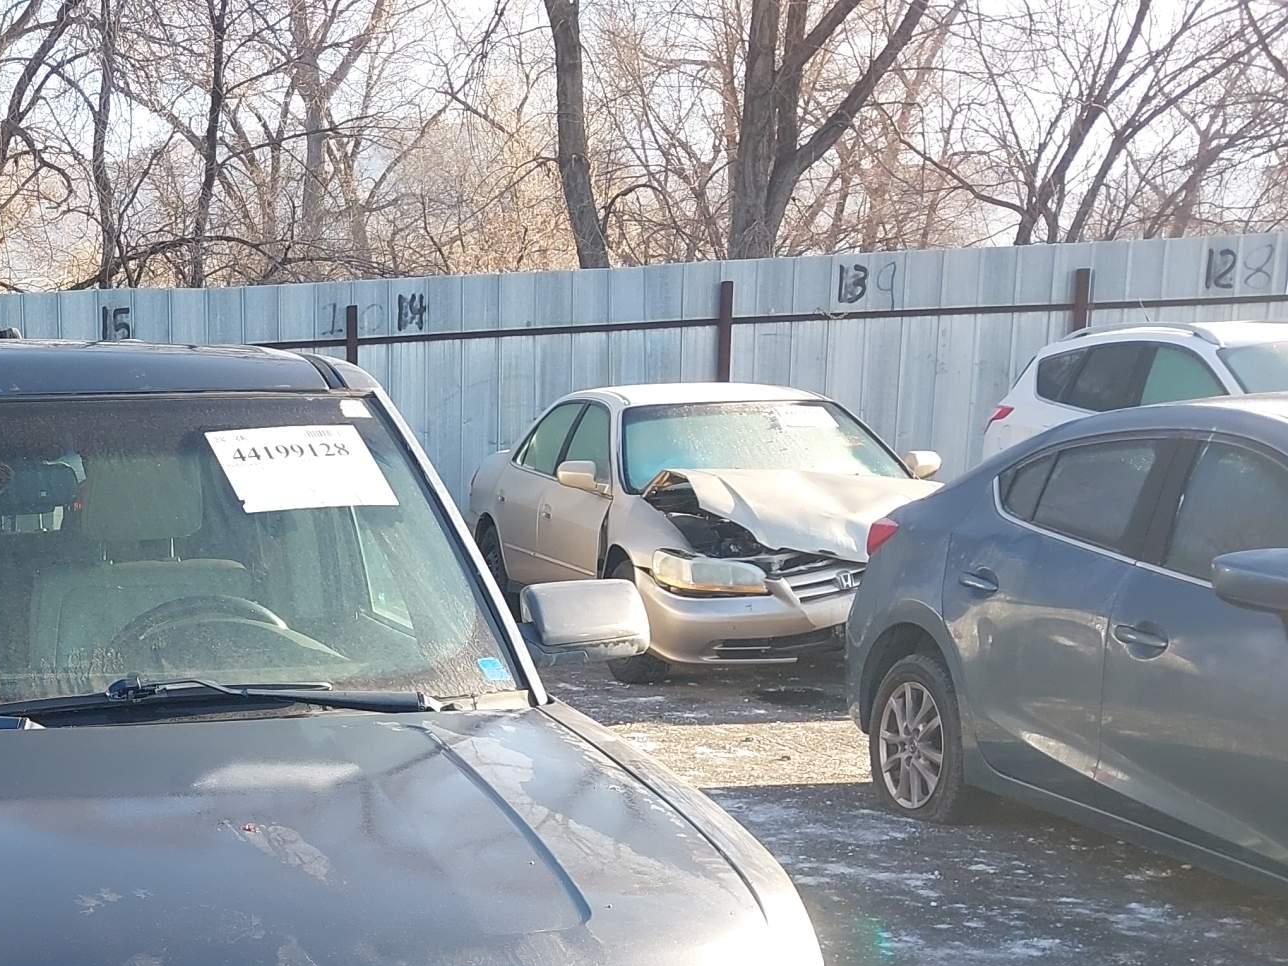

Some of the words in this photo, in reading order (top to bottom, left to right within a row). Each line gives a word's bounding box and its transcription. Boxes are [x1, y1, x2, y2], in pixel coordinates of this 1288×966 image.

[1205, 248, 1237, 289] 12
[102, 306, 131, 340] 15
[232, 442, 350, 462] 44199128
